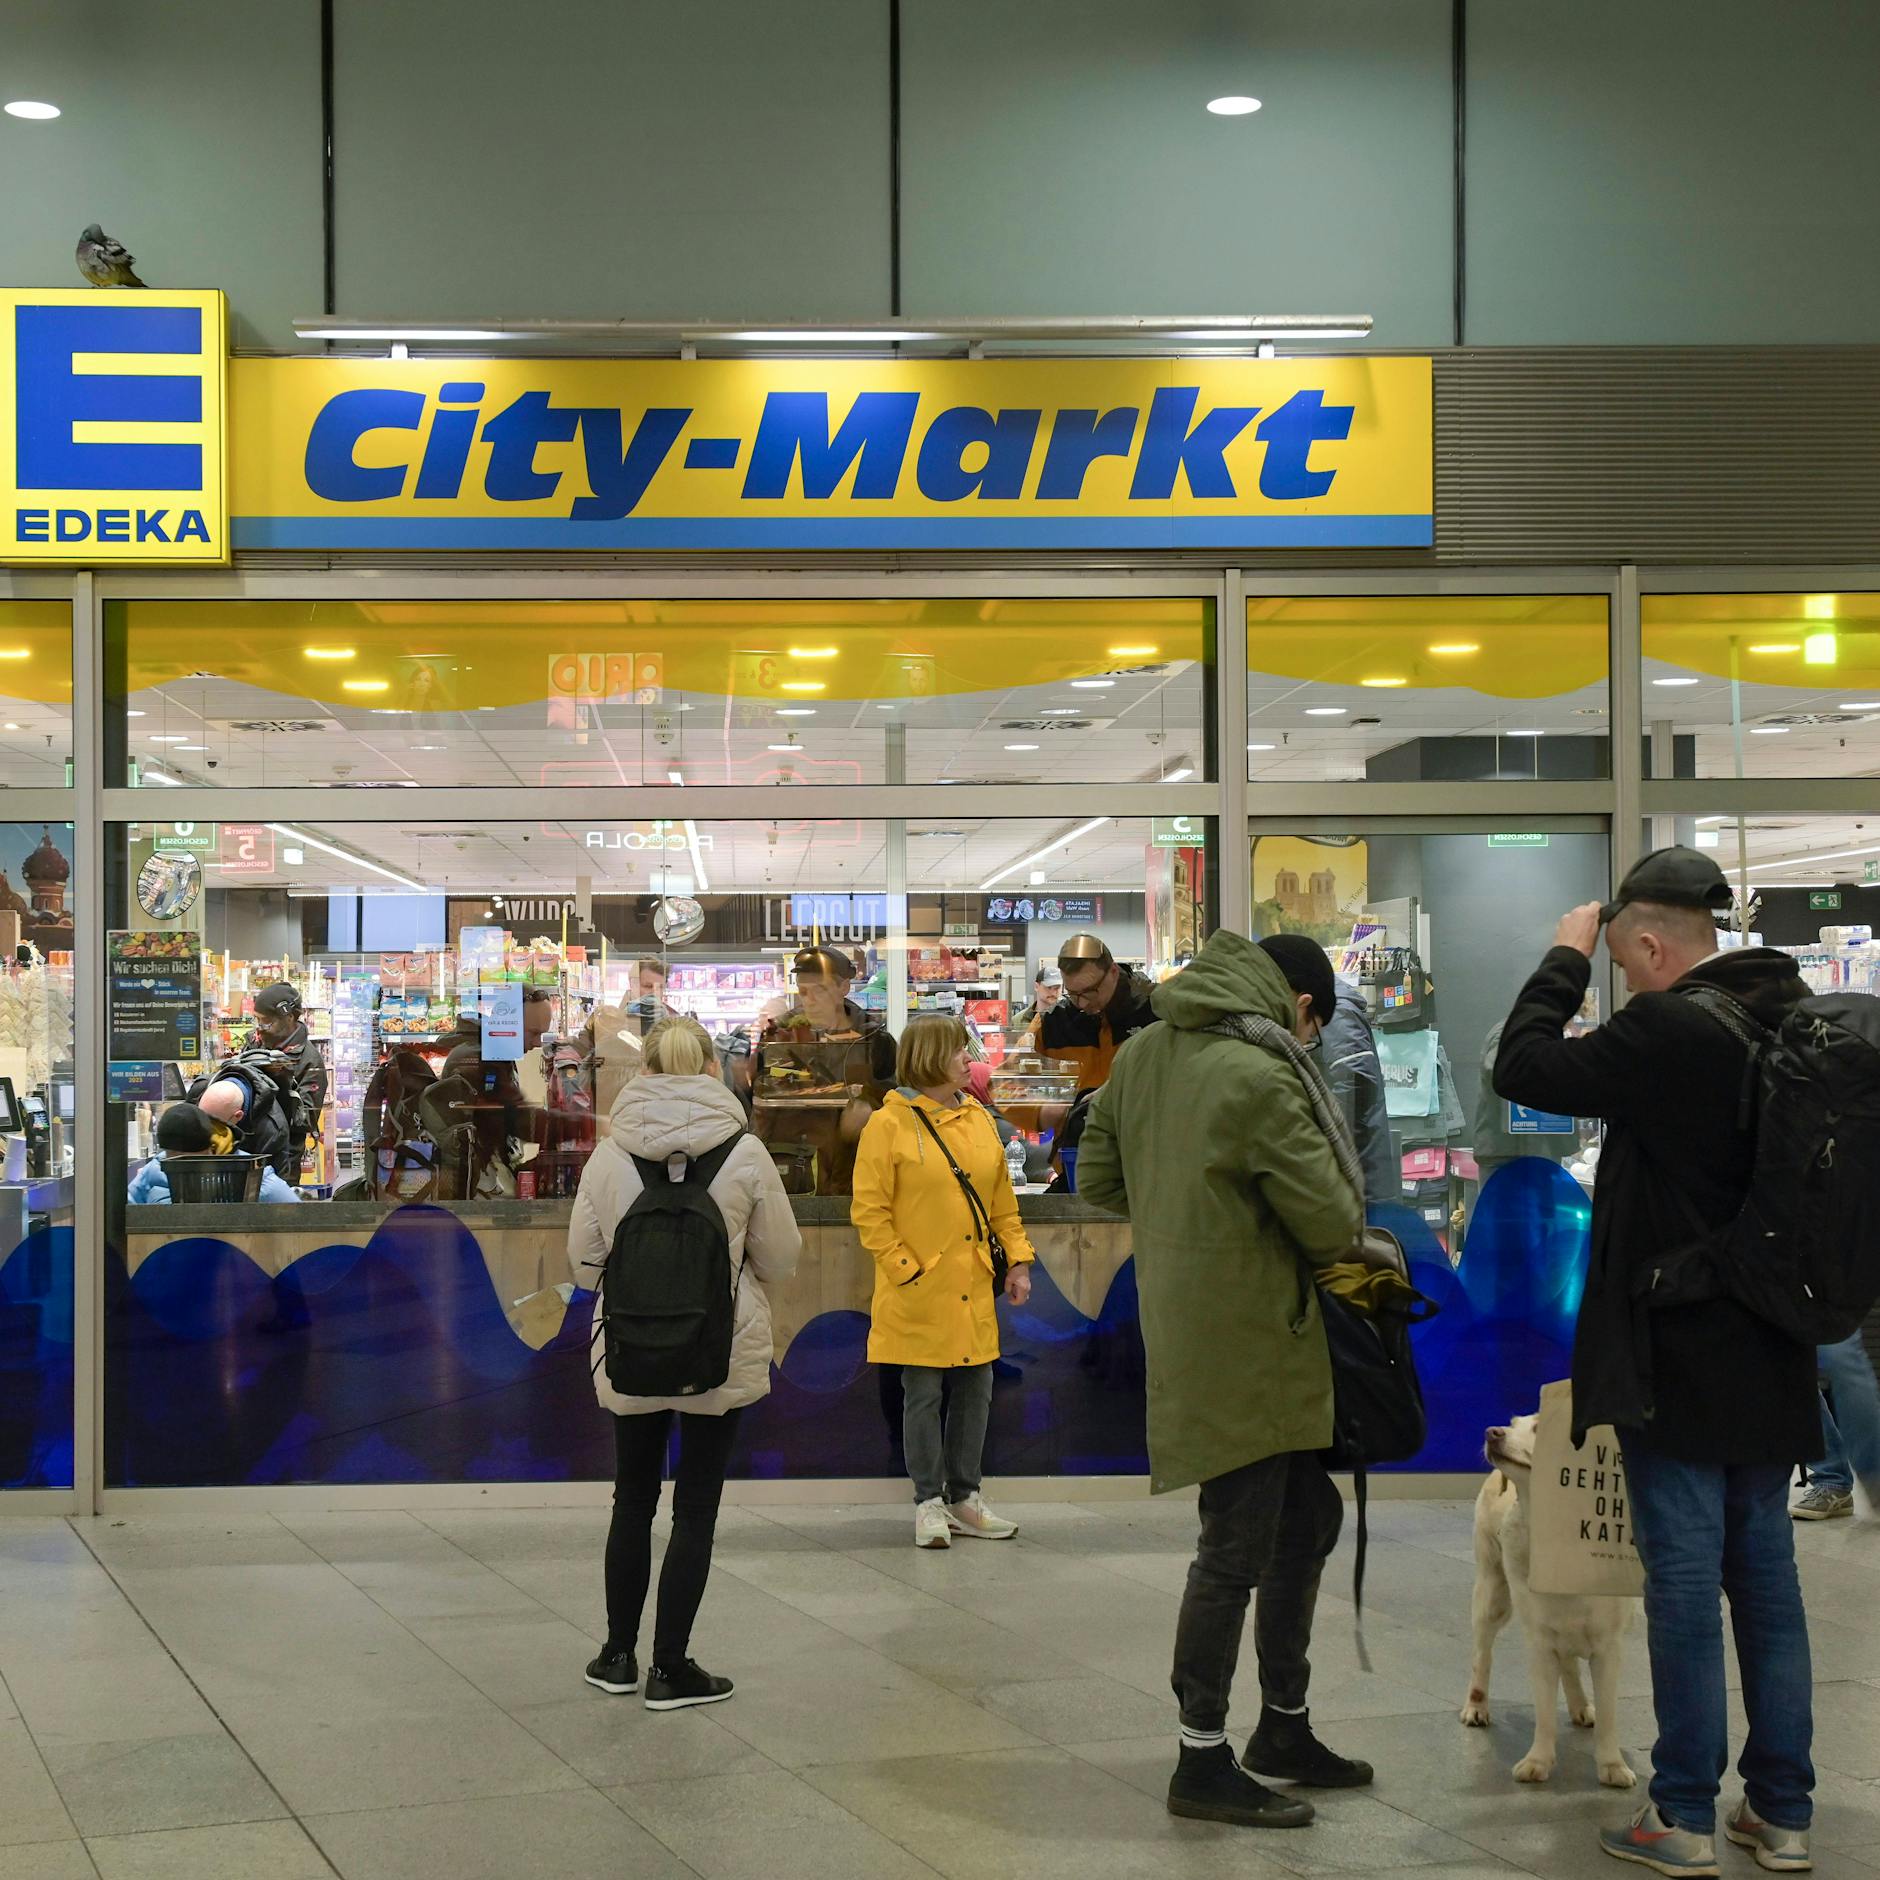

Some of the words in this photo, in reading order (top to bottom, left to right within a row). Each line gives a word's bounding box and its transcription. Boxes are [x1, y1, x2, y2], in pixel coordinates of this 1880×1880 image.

[15, 305, 202, 490] E
[304, 382, 1355, 521] City-Markt
[16, 509, 211, 544] EDEKA
[766, 899, 880, 942] LEERGUT
[113, 961, 131, 974] Wir
[133, 961, 169, 974] suchen
[172, 961, 197, 974] Dich!
[1560, 1467, 1621, 1493] GEHT
[1596, 1496, 1624, 1518] OH
[1580, 1519, 1636, 1545] KAT
